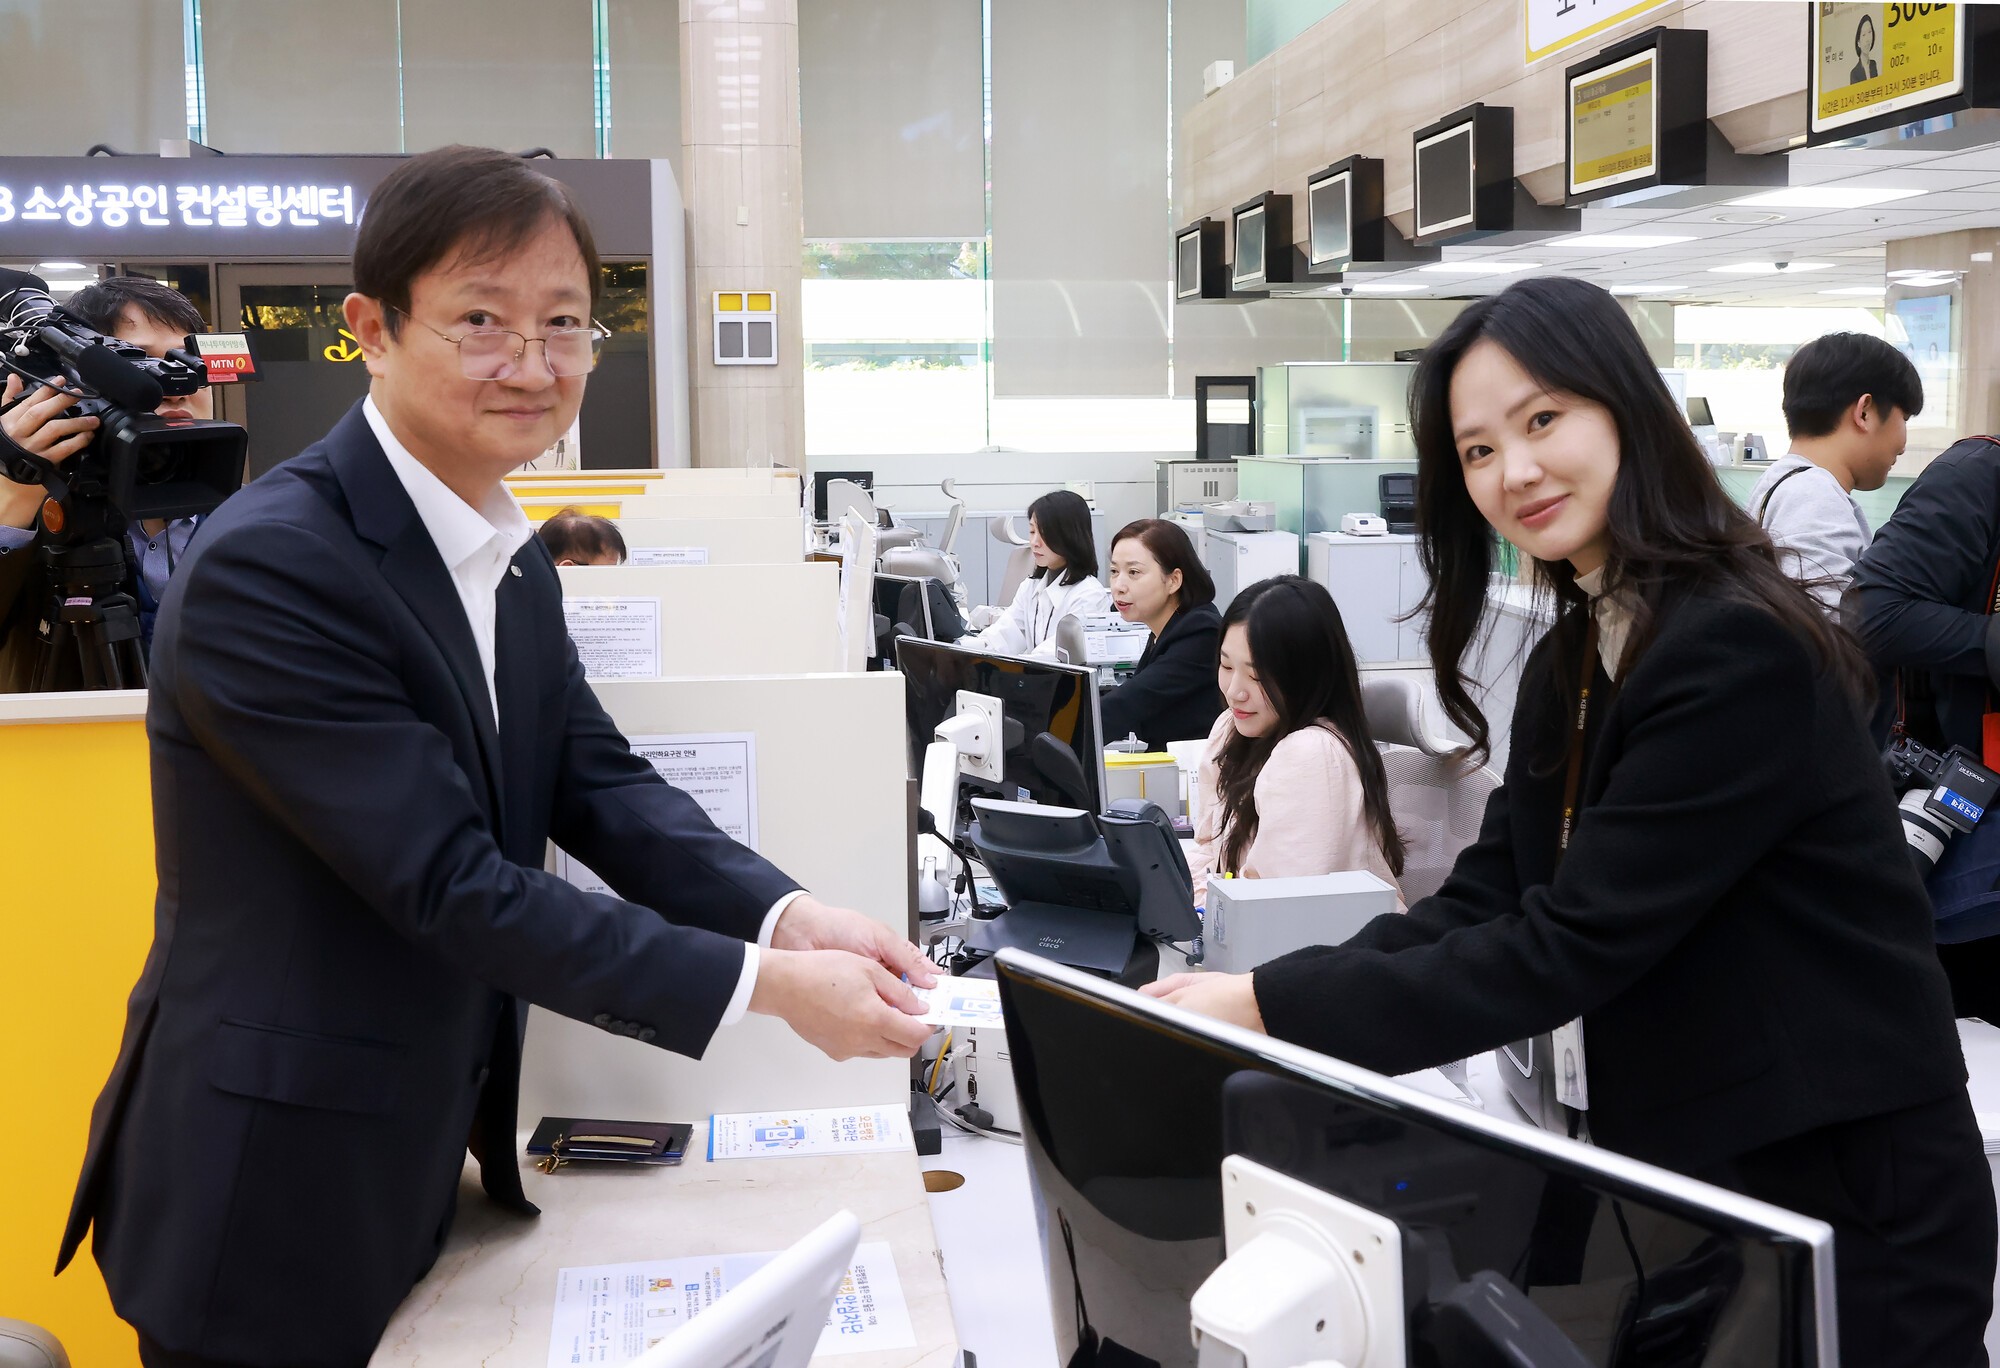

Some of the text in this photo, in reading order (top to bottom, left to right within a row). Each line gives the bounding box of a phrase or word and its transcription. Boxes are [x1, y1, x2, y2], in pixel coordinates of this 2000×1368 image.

[1928, 43, 1938, 57] 10
[1890, 54, 1905, 68] 002
[1856, 88, 1883, 105] 30분부터
[1885, 83, 1900, 96] 13시
[1902, 76, 1917, 91] 30분
[22, 184, 170, 227] 소상공인
[176, 184, 354, 227] 컨설팅센터
[211, 359, 234, 369] MTN
[683, 749, 697, 757] 안내
